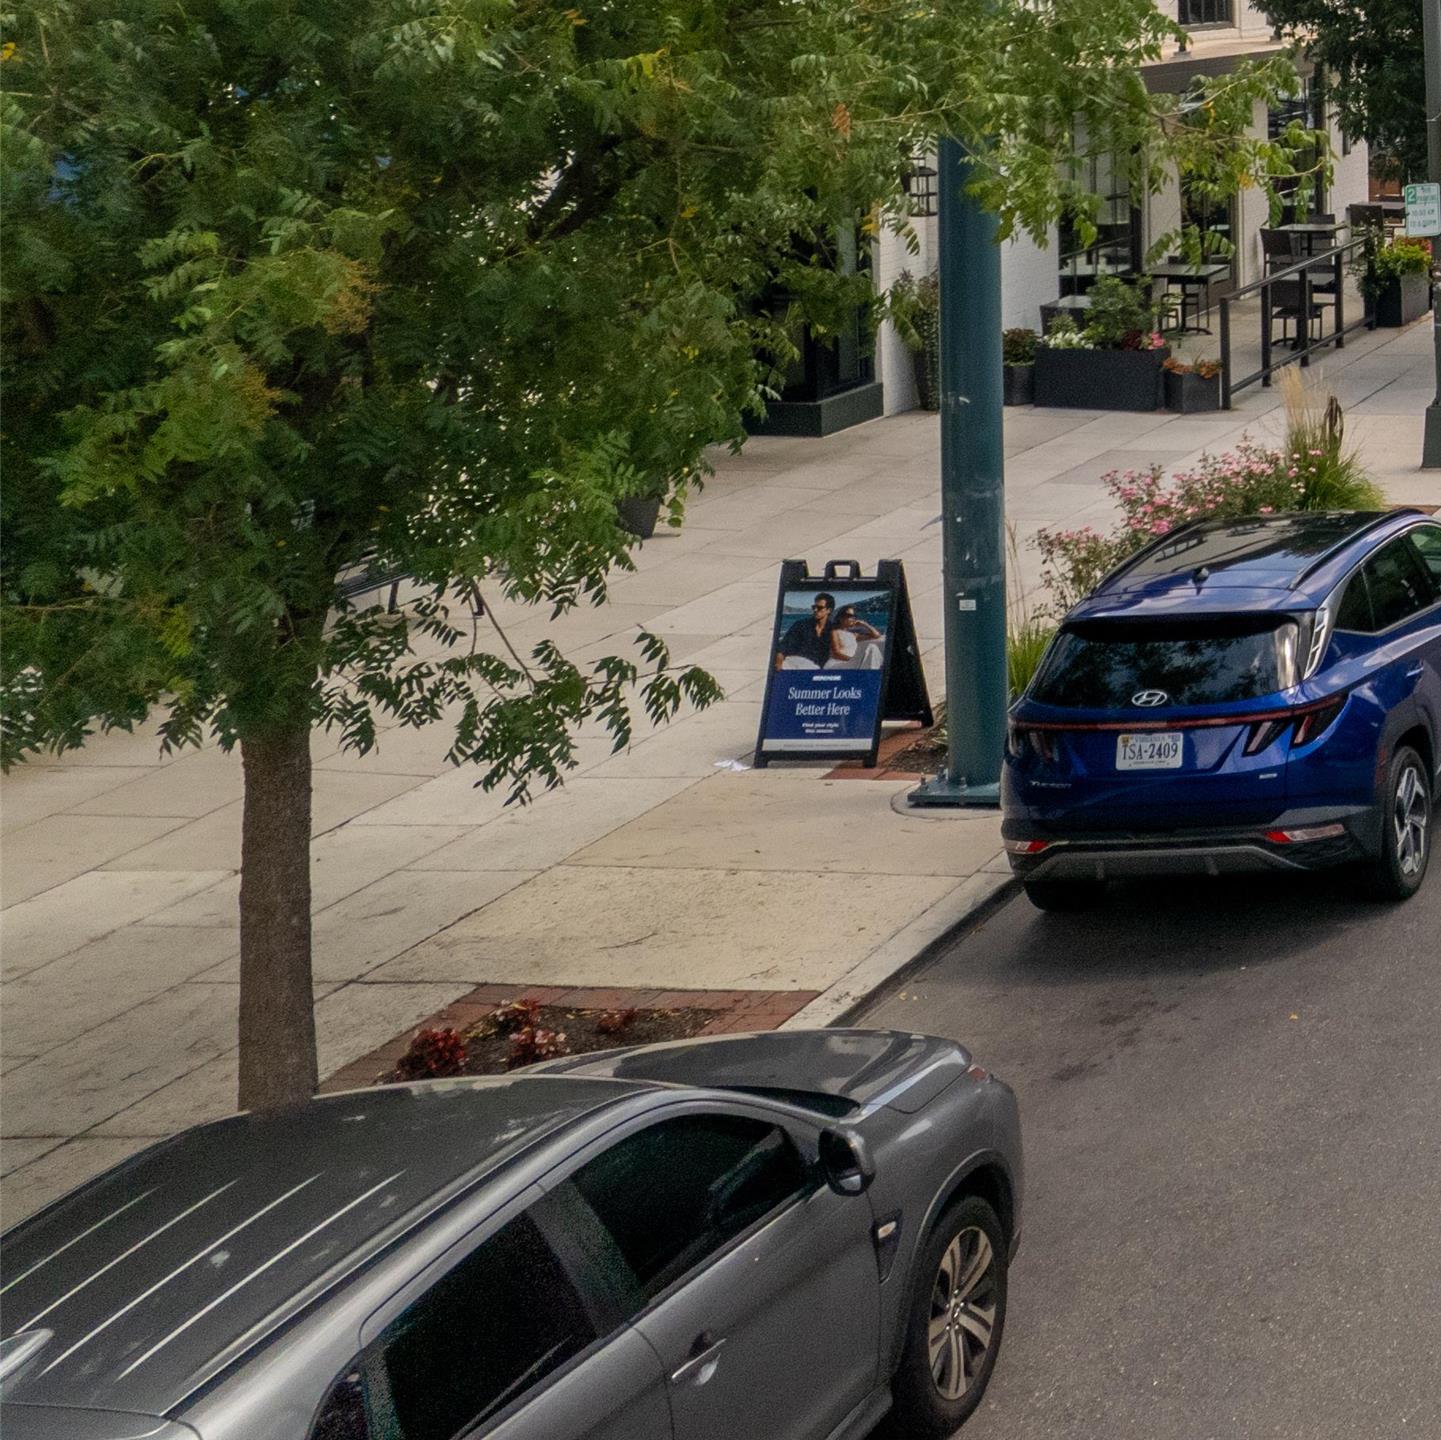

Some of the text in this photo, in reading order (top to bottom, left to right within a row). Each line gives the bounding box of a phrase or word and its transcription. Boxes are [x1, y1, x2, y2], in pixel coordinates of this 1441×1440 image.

[1408, 189, 1415, 202] 2
[788, 687, 862, 700] Summer Looks
[795, 703, 850, 715] Better Here
[1122, 742, 1178, 761] TSA-2409
